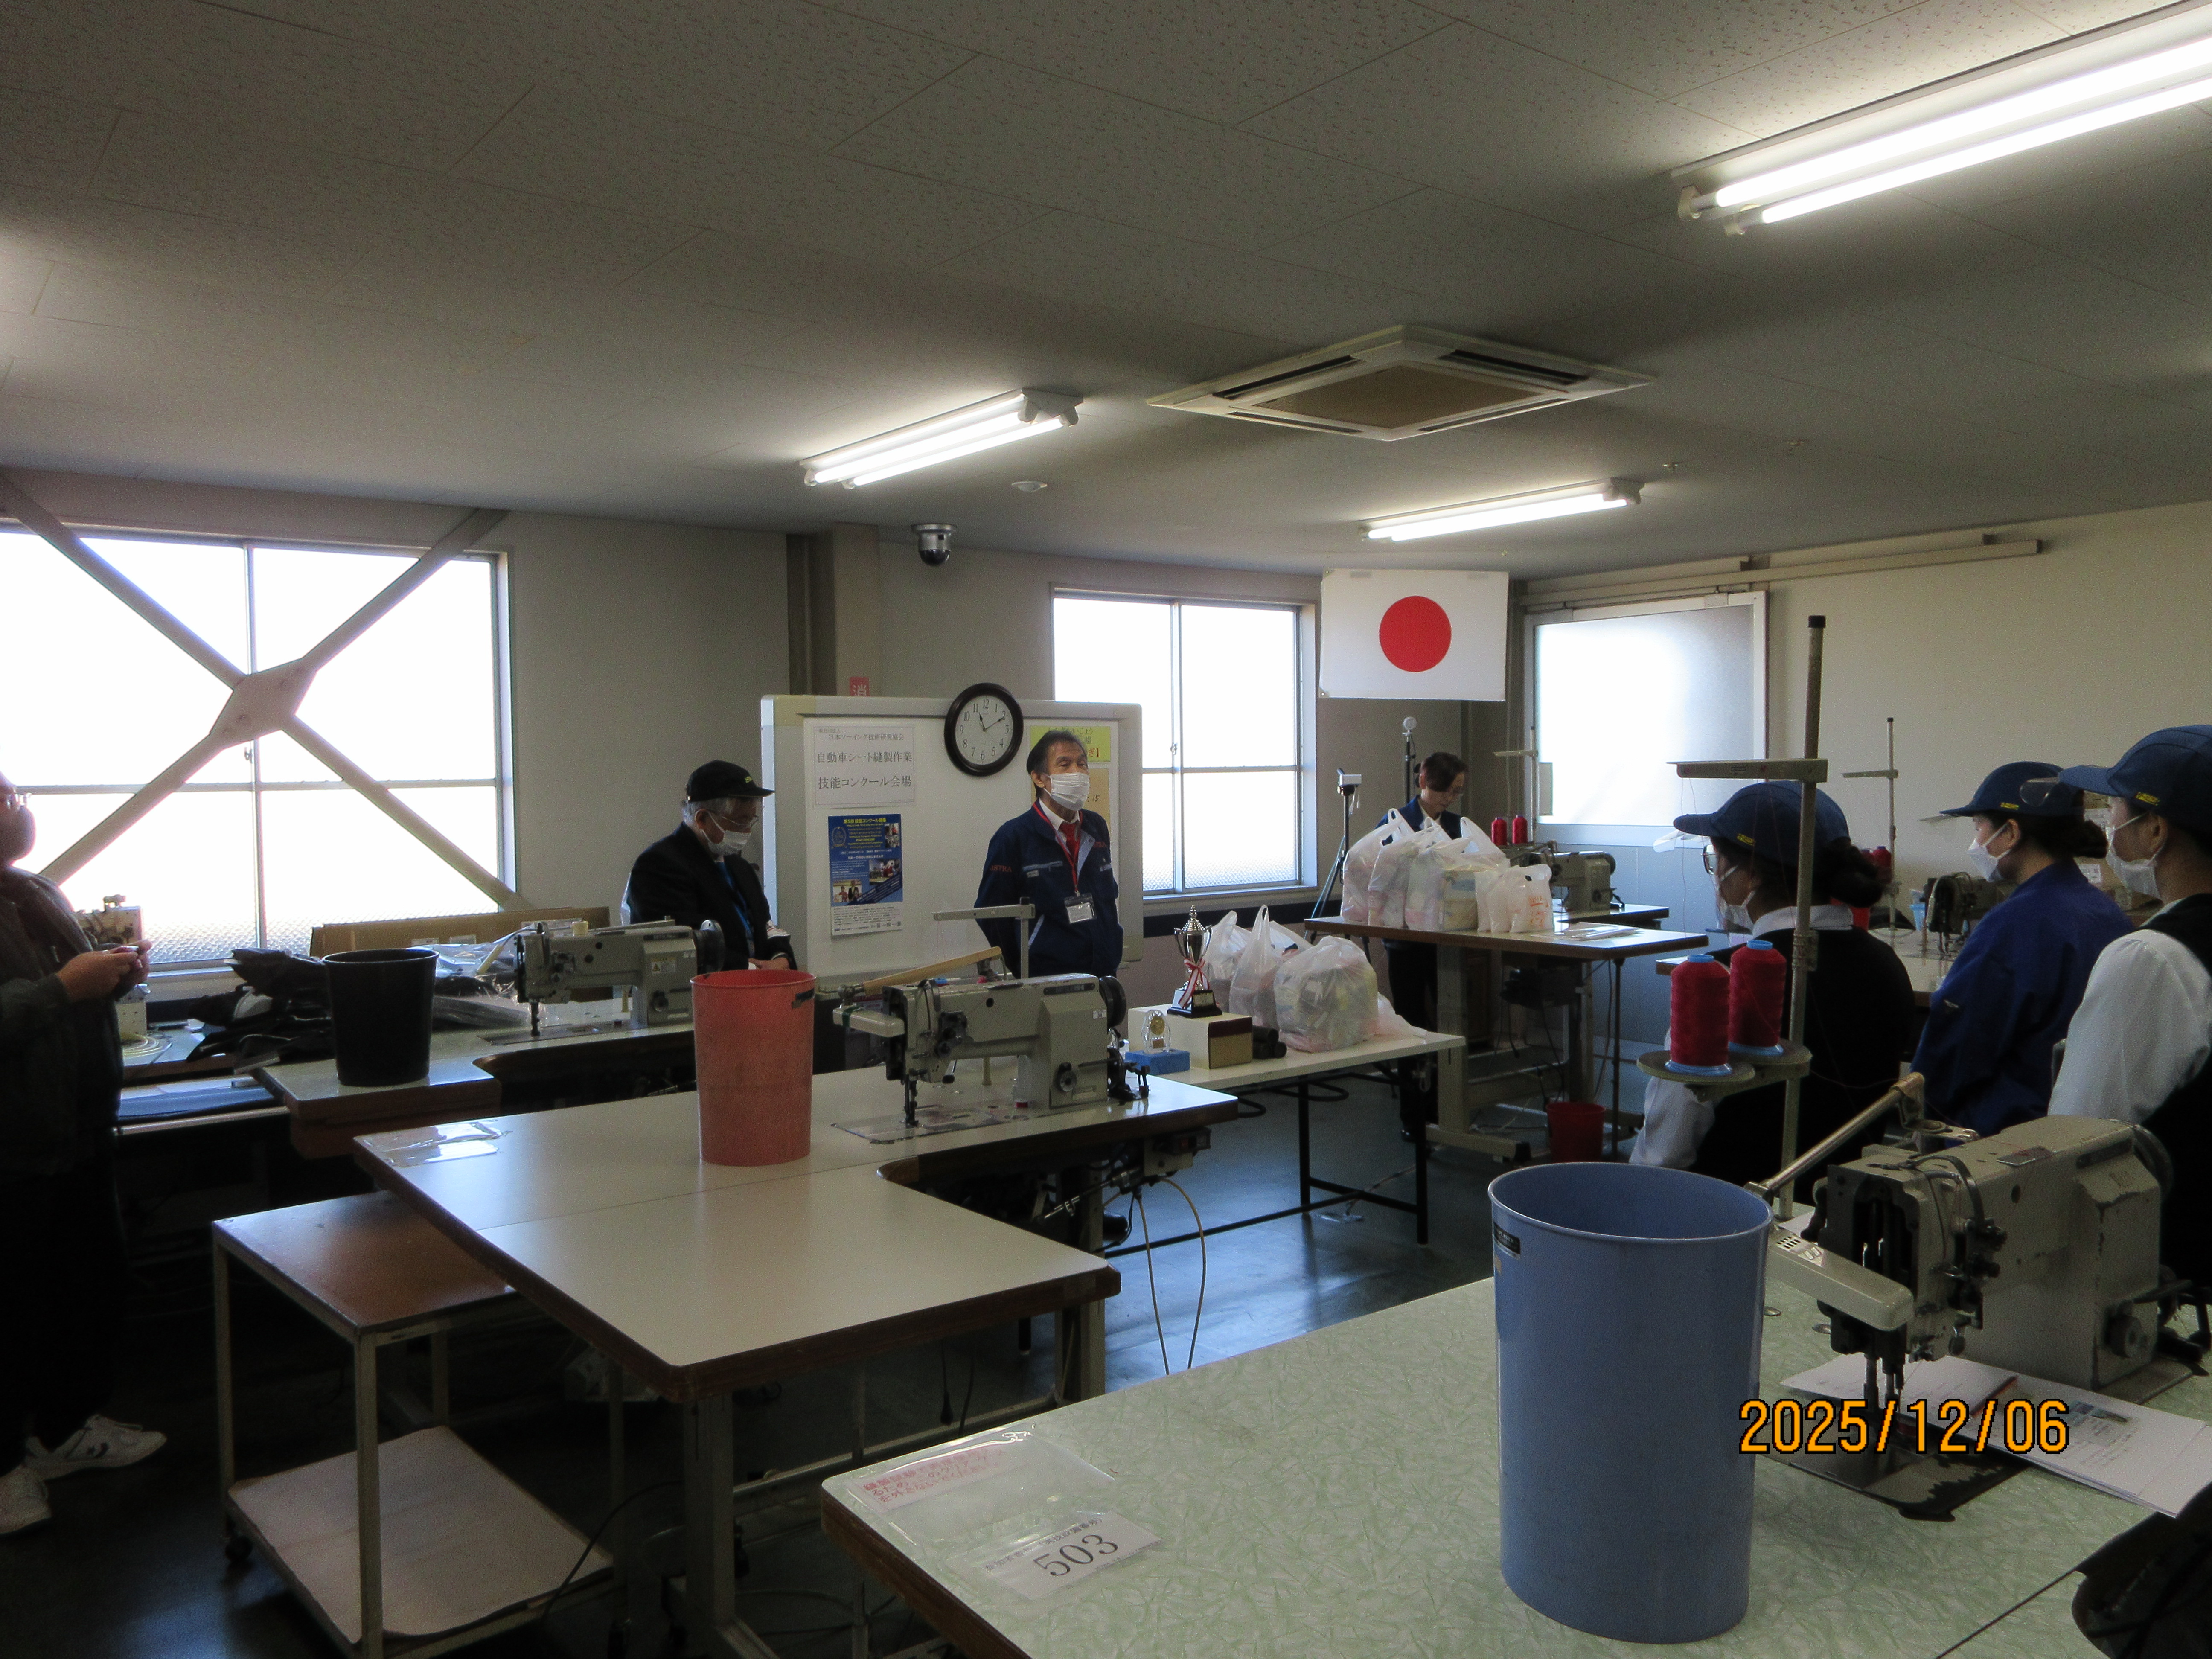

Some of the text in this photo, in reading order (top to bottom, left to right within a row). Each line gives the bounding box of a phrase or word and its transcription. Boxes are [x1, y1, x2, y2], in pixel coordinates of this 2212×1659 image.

[973, 704, 978, 712] 11
[983, 699, 989, 709] 12
[995, 704, 997, 712] 1
[964, 711, 970, 721] 10
[1002, 711, 1006, 720] 2
[960, 725, 963, 734] 9
[1005, 725, 1009, 734] 3
[963, 739, 967, 748] 8
[999, 738, 1003, 747] 4
[972, 748, 975, 756] 7
[981, 751, 985, 760] 6
[992, 747, 995, 756] 5
[818, 751, 912, 763] 自動車シート縫製作業
[818, 775, 912, 789] 技能コンクール会場
[1033, 1534, 1118, 1576] 503
